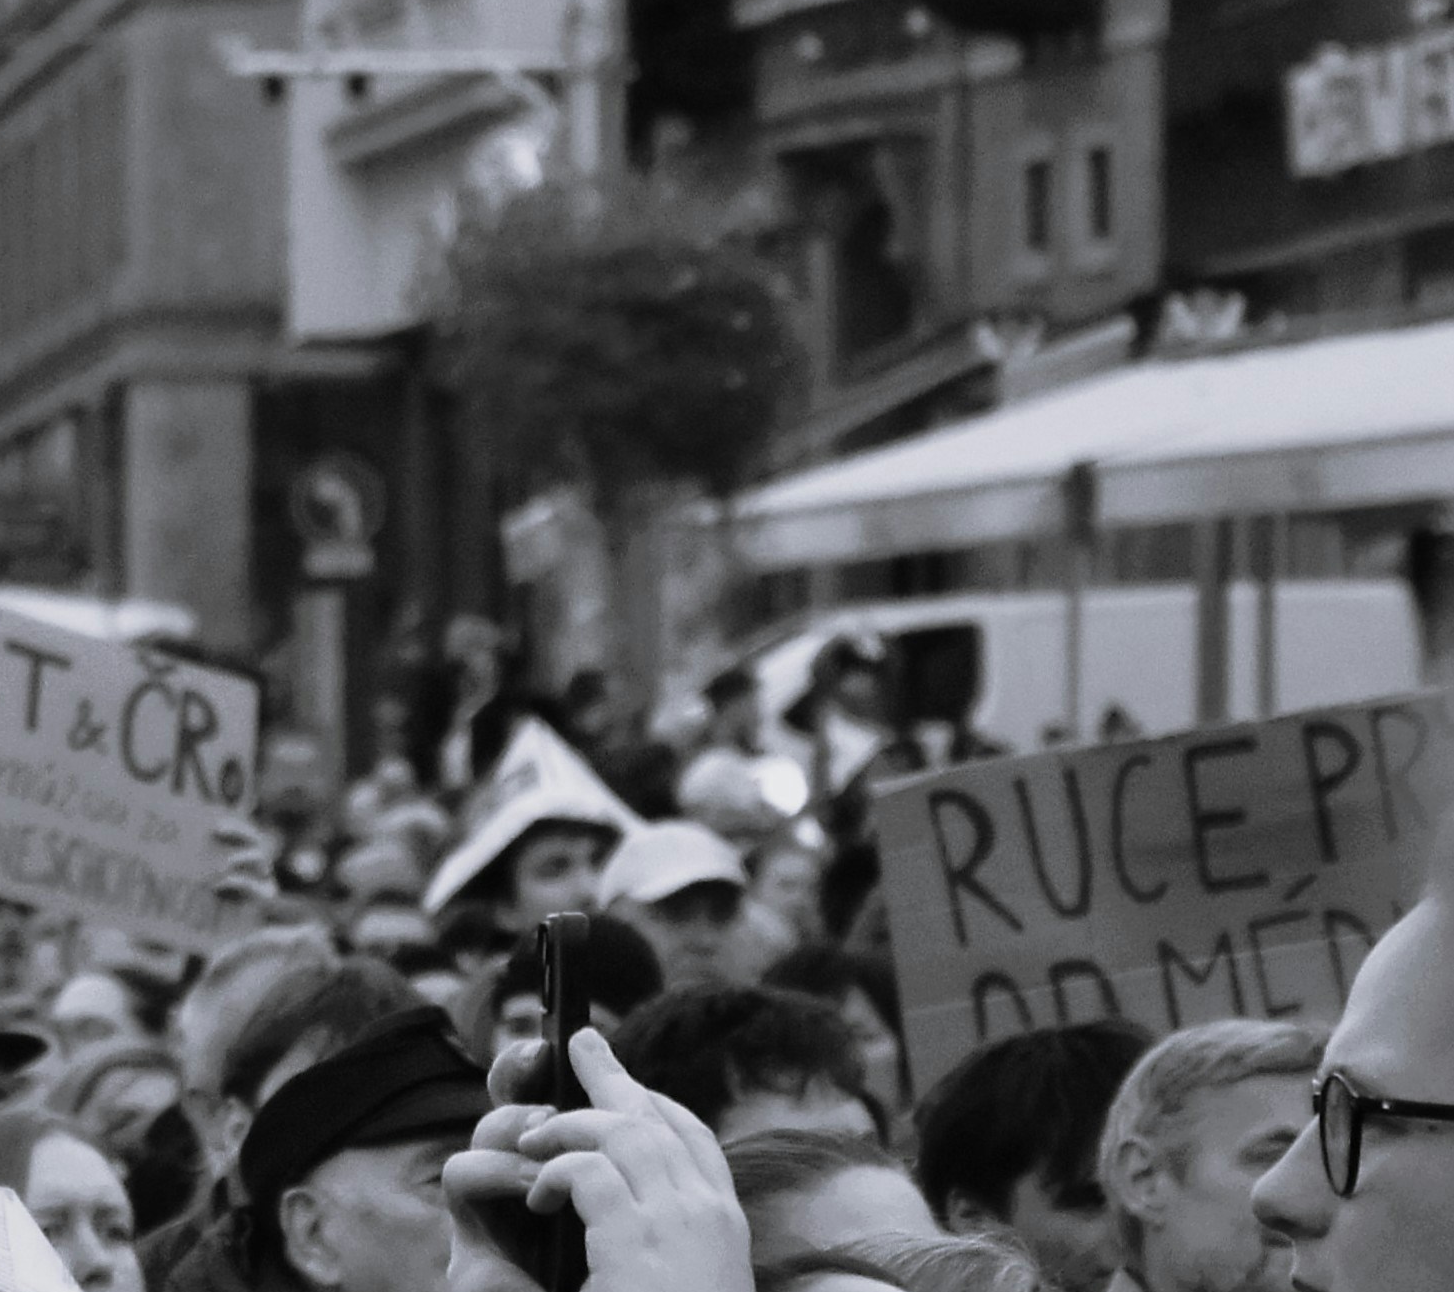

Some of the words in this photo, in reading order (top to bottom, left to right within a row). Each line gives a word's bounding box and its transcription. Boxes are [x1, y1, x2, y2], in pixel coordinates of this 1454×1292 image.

[927, 736, 1270, 947] RUCE
[1302, 708, 1429, 864] PR
[1156, 874, 1405, 1028] MÉD
